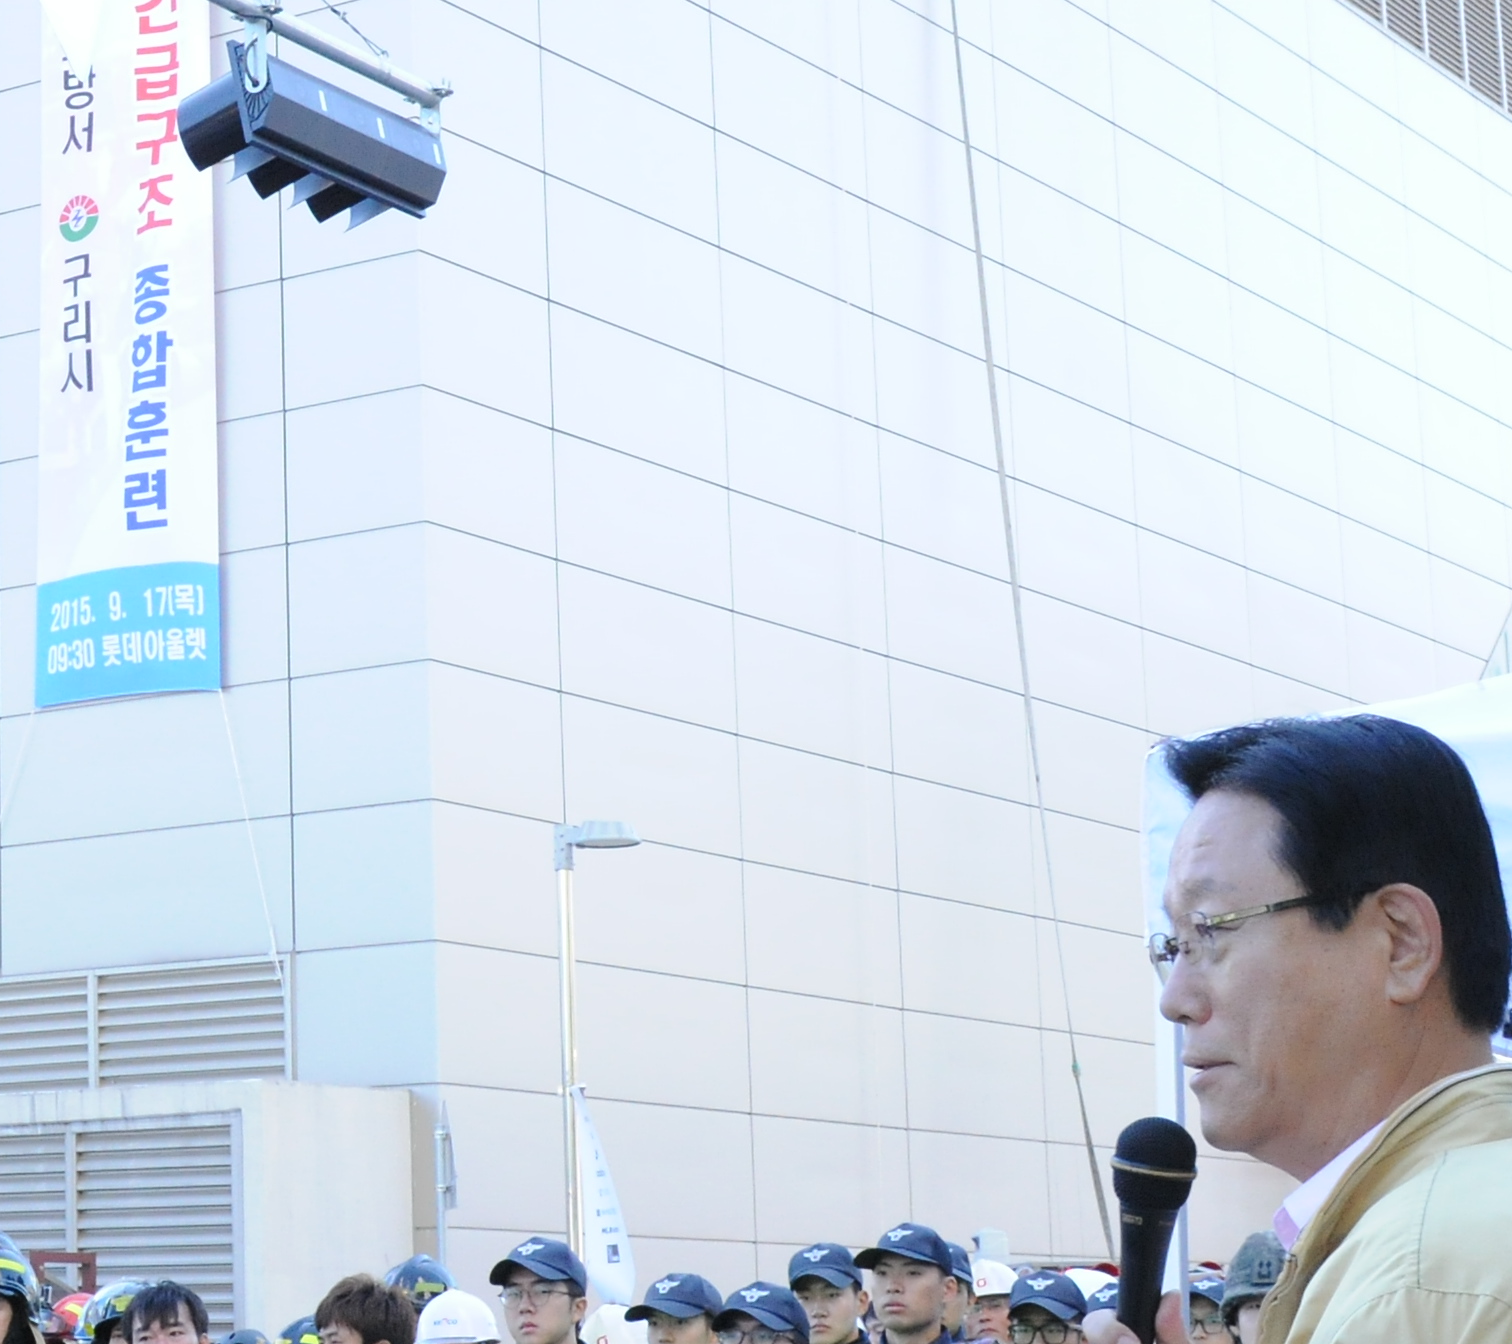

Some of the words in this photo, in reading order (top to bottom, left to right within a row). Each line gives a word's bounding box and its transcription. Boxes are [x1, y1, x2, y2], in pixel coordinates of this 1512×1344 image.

[61, 253, 94, 393] 구리시
[123, 263, 174, 532] 종합훈련
[47, 638, 96, 675] 09:30
[101, 627, 207, 668] 롯데아울렛
[49, 595, 96, 632] 2015.
